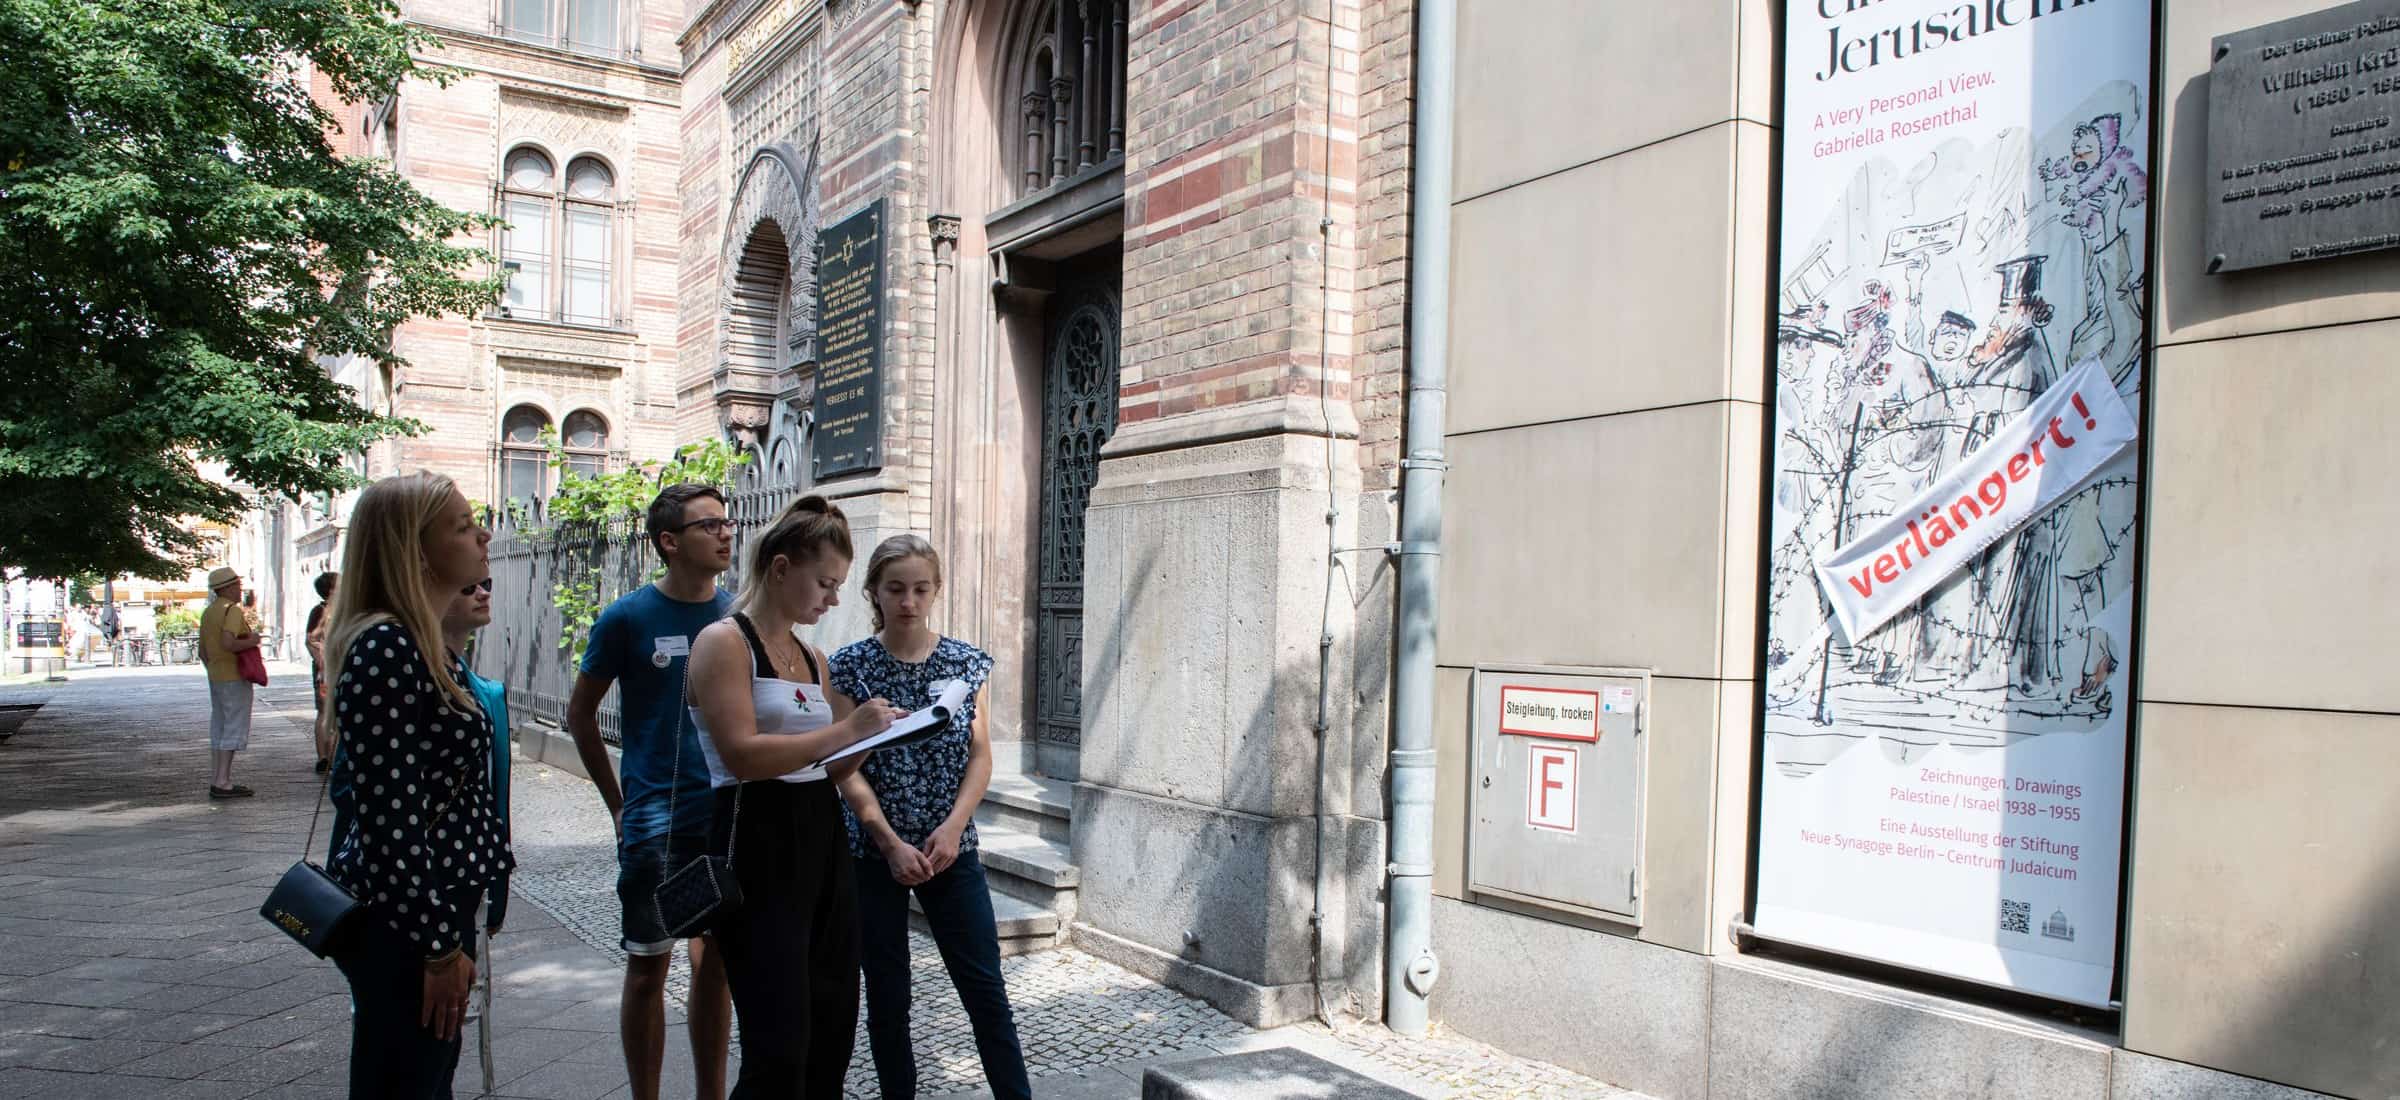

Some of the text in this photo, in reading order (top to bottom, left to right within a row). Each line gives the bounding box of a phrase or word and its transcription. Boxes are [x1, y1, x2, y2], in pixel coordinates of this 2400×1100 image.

[2262, 44, 2290, 62] Der
[2293, 29, 2354, 54] Berliner
[2262, 60, 2350, 94] Wilhelm
[1814, 71, 1996, 131] A Very Personal View.
[2307, 85, 2352, 109] 1880
[1814, 101, 1978, 158] Gabriella Rosenthal
[1561, 706, 1593, 721] trocken
[1540, 755, 1565, 817] F
[1890, 787, 1950, 807] Palestine
[1963, 795, 2001, 812] Israel
[1921, 768, 2082, 800] Zeichnungen. Drawings
[1801, 828, 1832, 845] Neue
[1835, 833, 1893, 855] Synagoge
[2010, 857, 2078, 881] Judaicum
[1880, 818, 2080, 861] Eine Ausstellung der Stiftung
